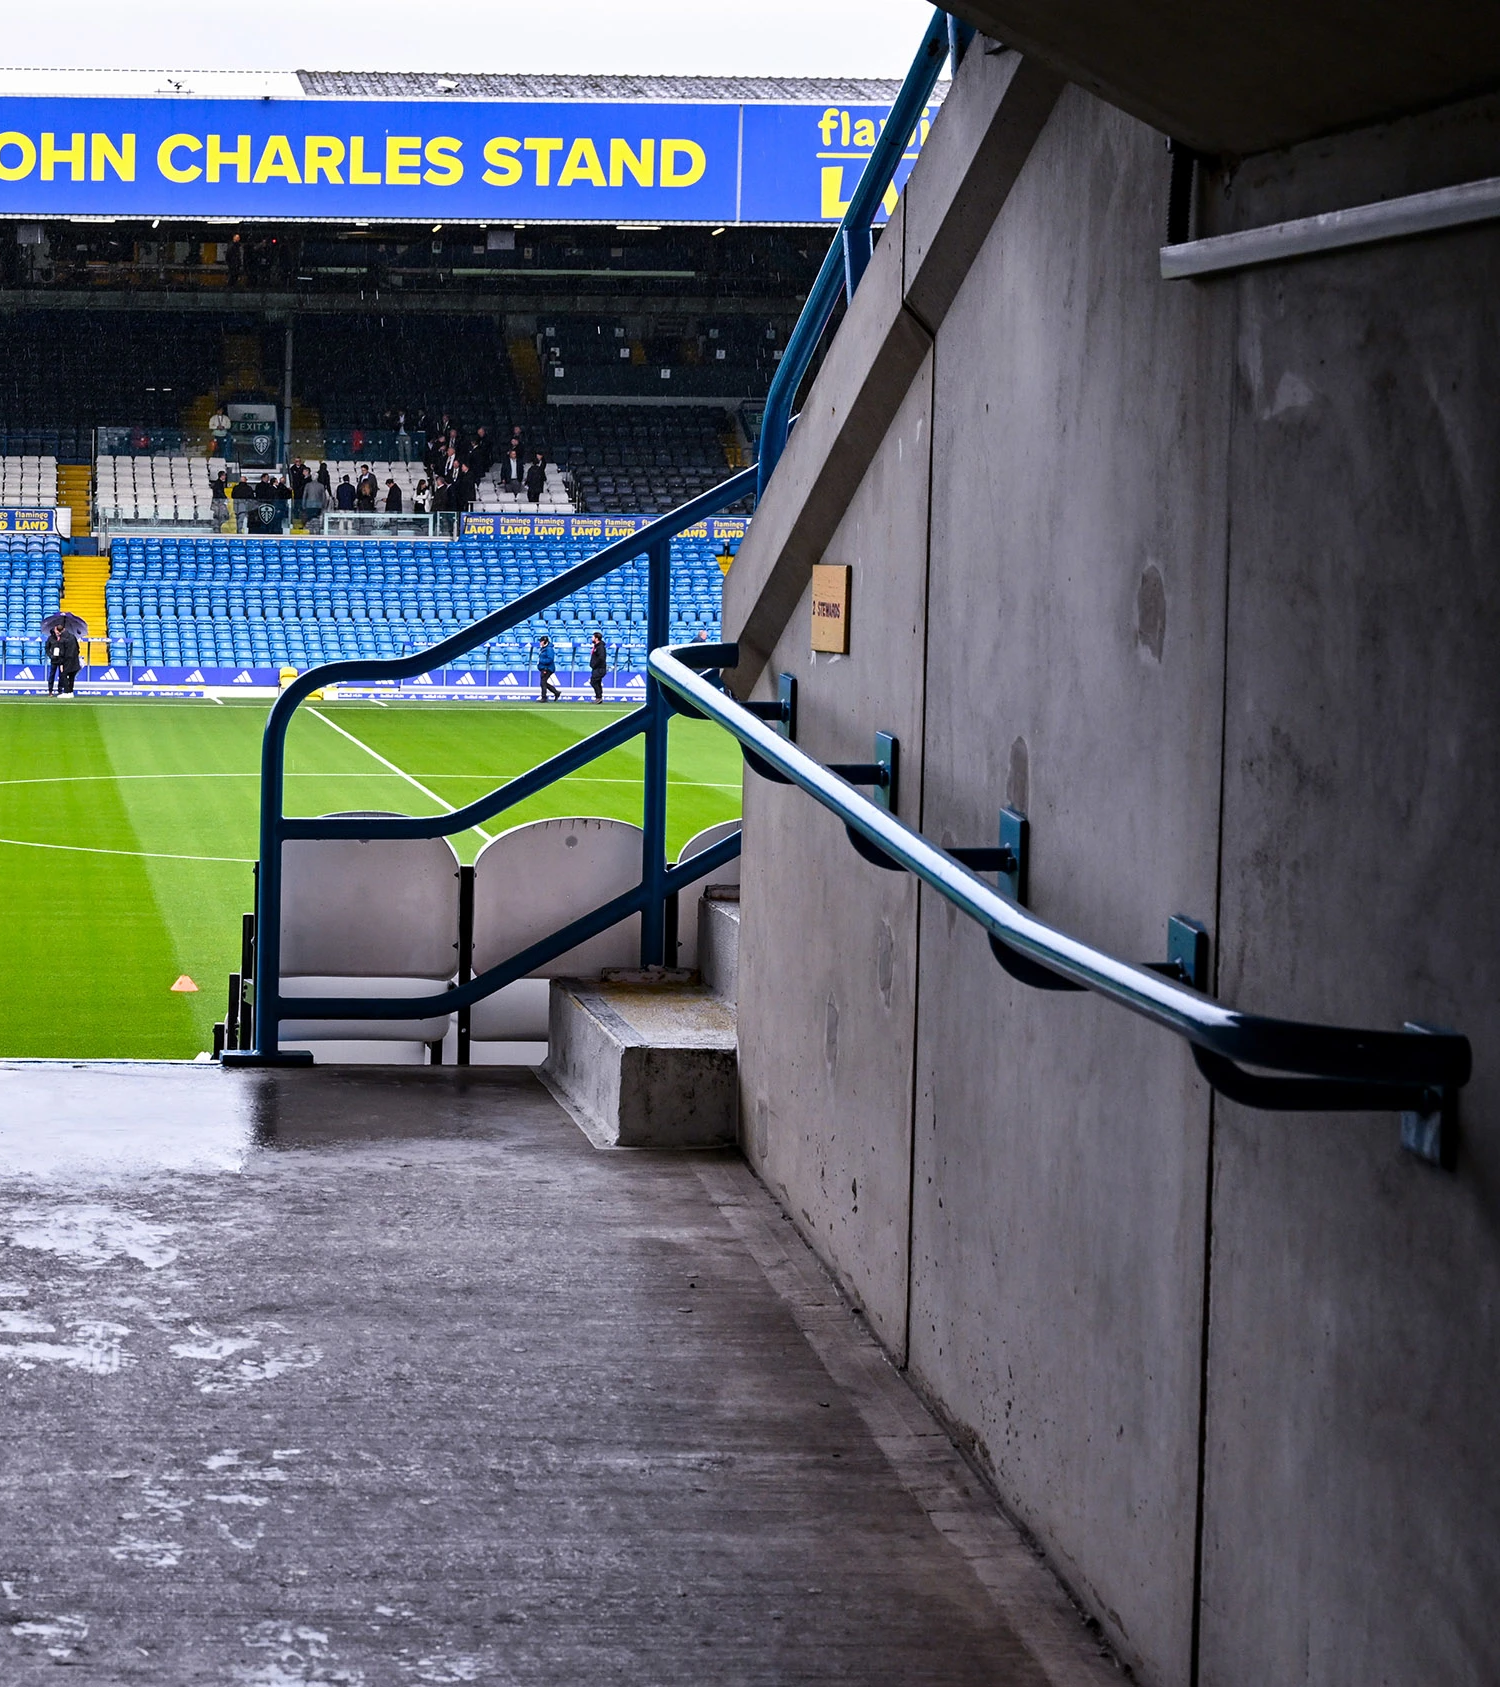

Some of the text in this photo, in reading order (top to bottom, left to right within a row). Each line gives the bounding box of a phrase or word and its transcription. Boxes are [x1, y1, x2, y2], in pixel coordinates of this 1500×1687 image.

[157, 135, 465, 186] CHARLES
[482, 137, 706, 187] STAND
[15, 510, 48, 519] flamingo
[500, 516, 530, 525] flamingo
[534, 517, 564, 525] flamingo
[571, 518, 602, 526] flamingo
[604, 518, 636, 526] flamingo
[714, 520, 744, 528] flamingo
[15, 520, 49, 531] LAND
[464, 526, 494, 534] LAND
[500, 526, 531, 535] LAND
[534, 526, 564, 536] LAND
[572, 527, 602, 536] LAND
[714, 529, 744, 538] LAND
[818, 601, 841, 619] STEWARDS
